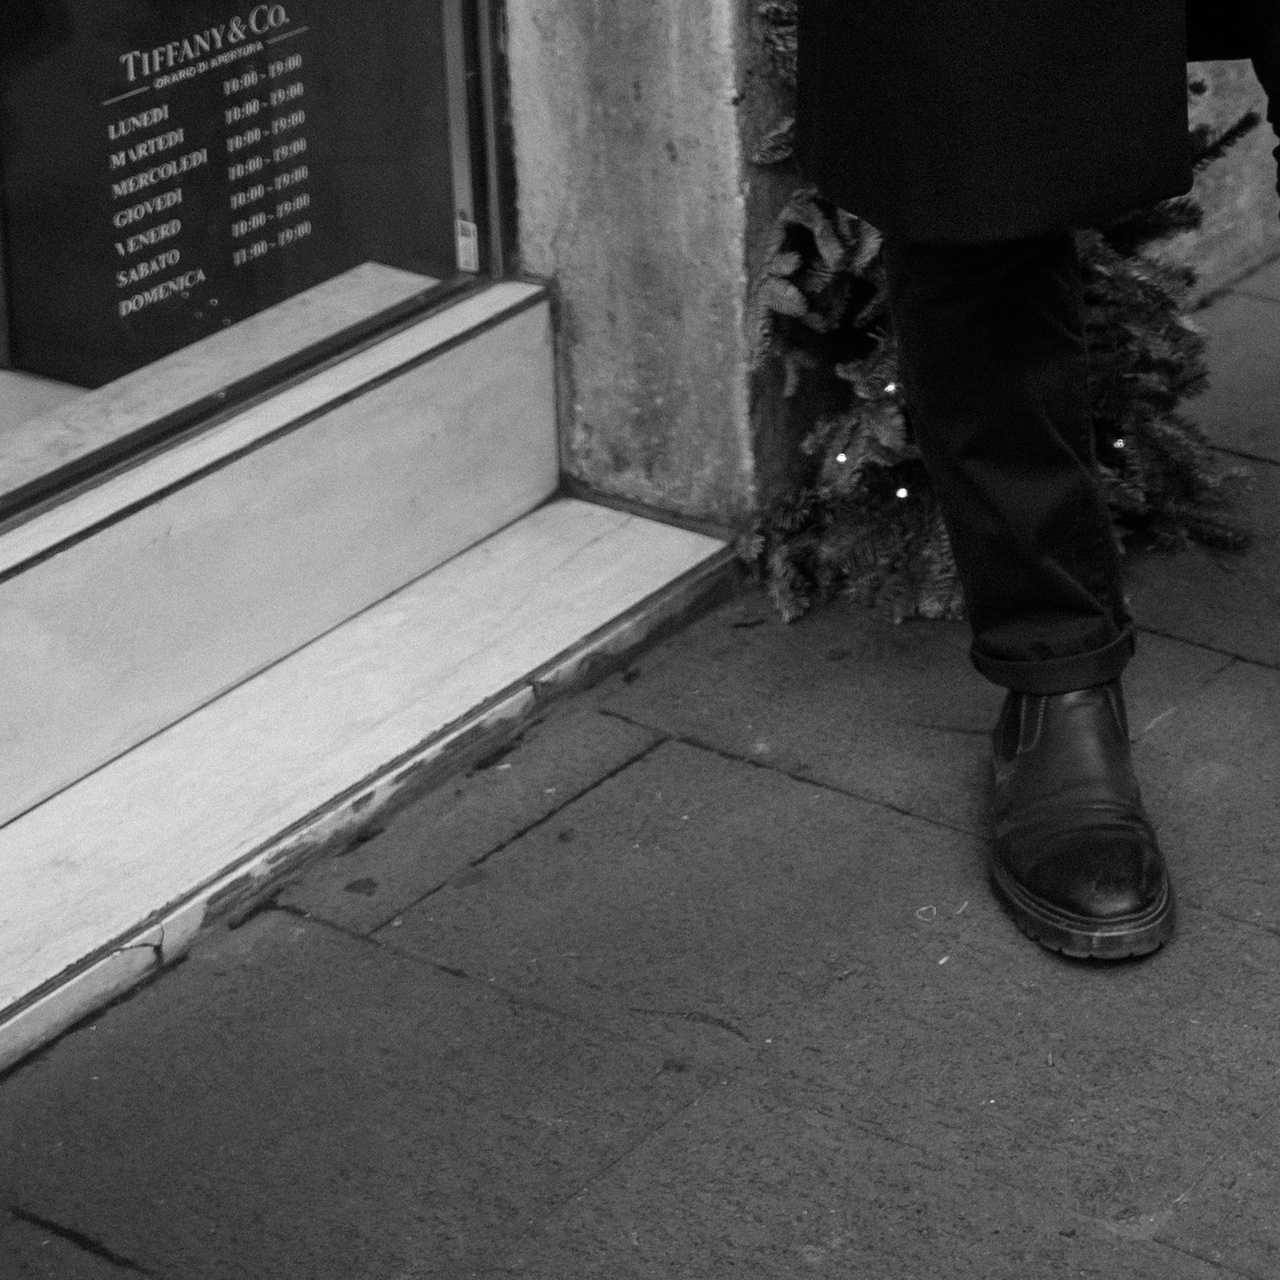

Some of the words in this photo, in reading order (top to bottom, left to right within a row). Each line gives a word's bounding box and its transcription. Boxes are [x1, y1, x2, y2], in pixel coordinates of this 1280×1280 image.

[153, 66, 196, 88] ORARIO
[210, 41, 264, 69] APERTURA
[108, 104, 169, 140] LUNEDI
[111, 148, 208, 199] MERCOLEDI
[112, 188, 183, 228] GIOVEDI
[116, 249, 180, 287] SABATO
[119, 268, 205, 317] DOMENICA
